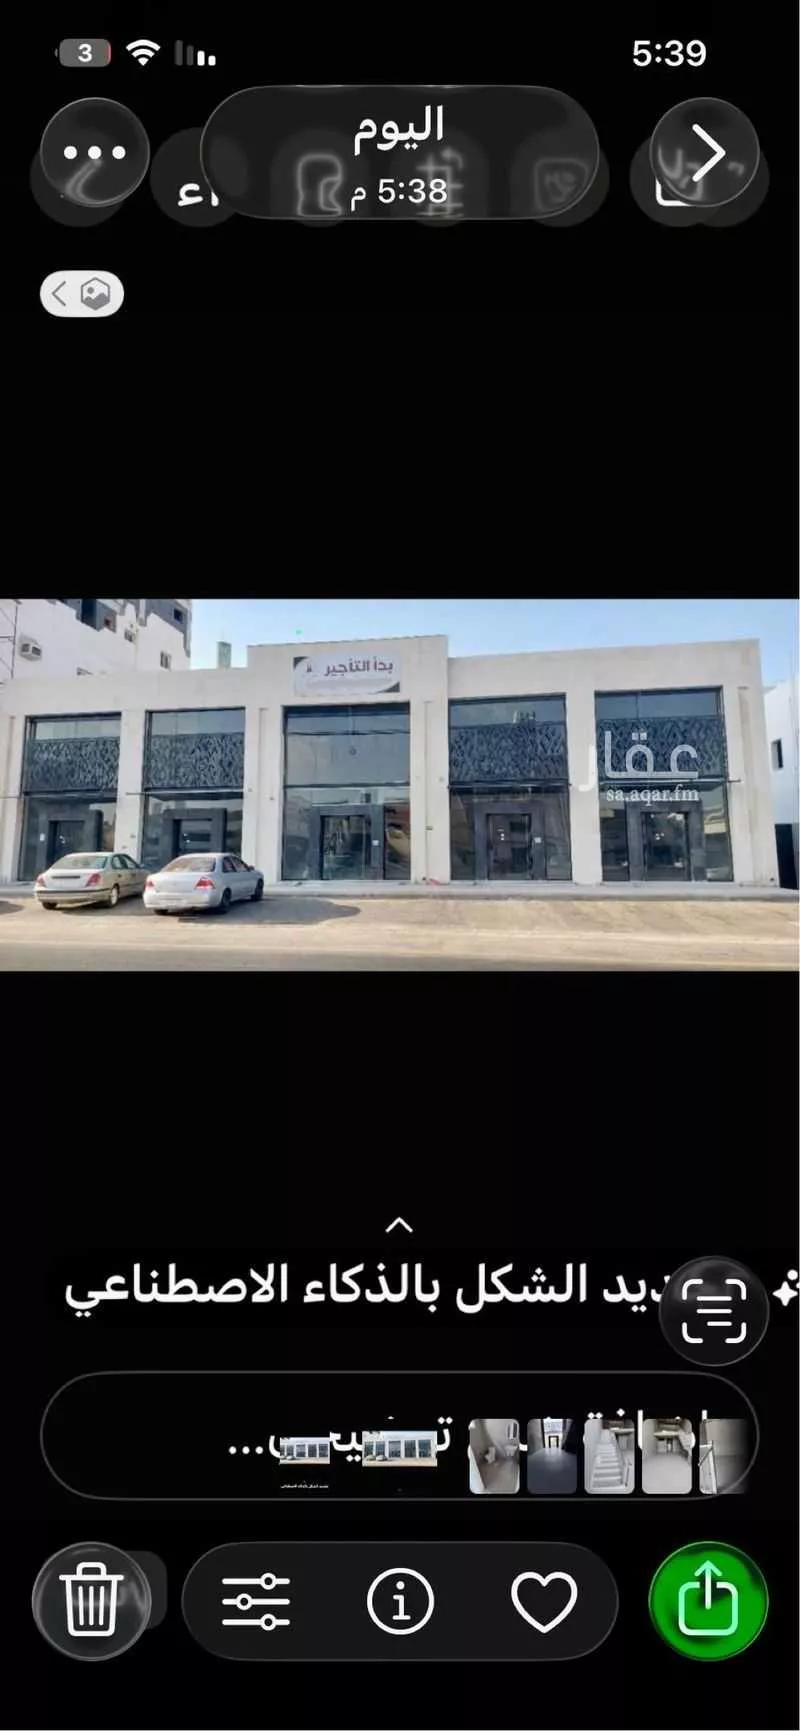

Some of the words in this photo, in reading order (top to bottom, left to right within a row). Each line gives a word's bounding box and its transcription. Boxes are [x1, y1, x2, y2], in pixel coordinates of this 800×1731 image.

[78, 43, 93, 63] 3
[632, 39, 707, 67] 5:39
[354, 105, 444, 155] اليوم
[350, 186, 367, 212] م
[378, 178, 448, 205] 5:38
[323, 657, 371, 677] التأجير
[65, 1262, 288, 1318] الاصطناعي
[303, 1262, 440, 1313] بالذكاء
[456, 1262, 588, 1314] الشكل
